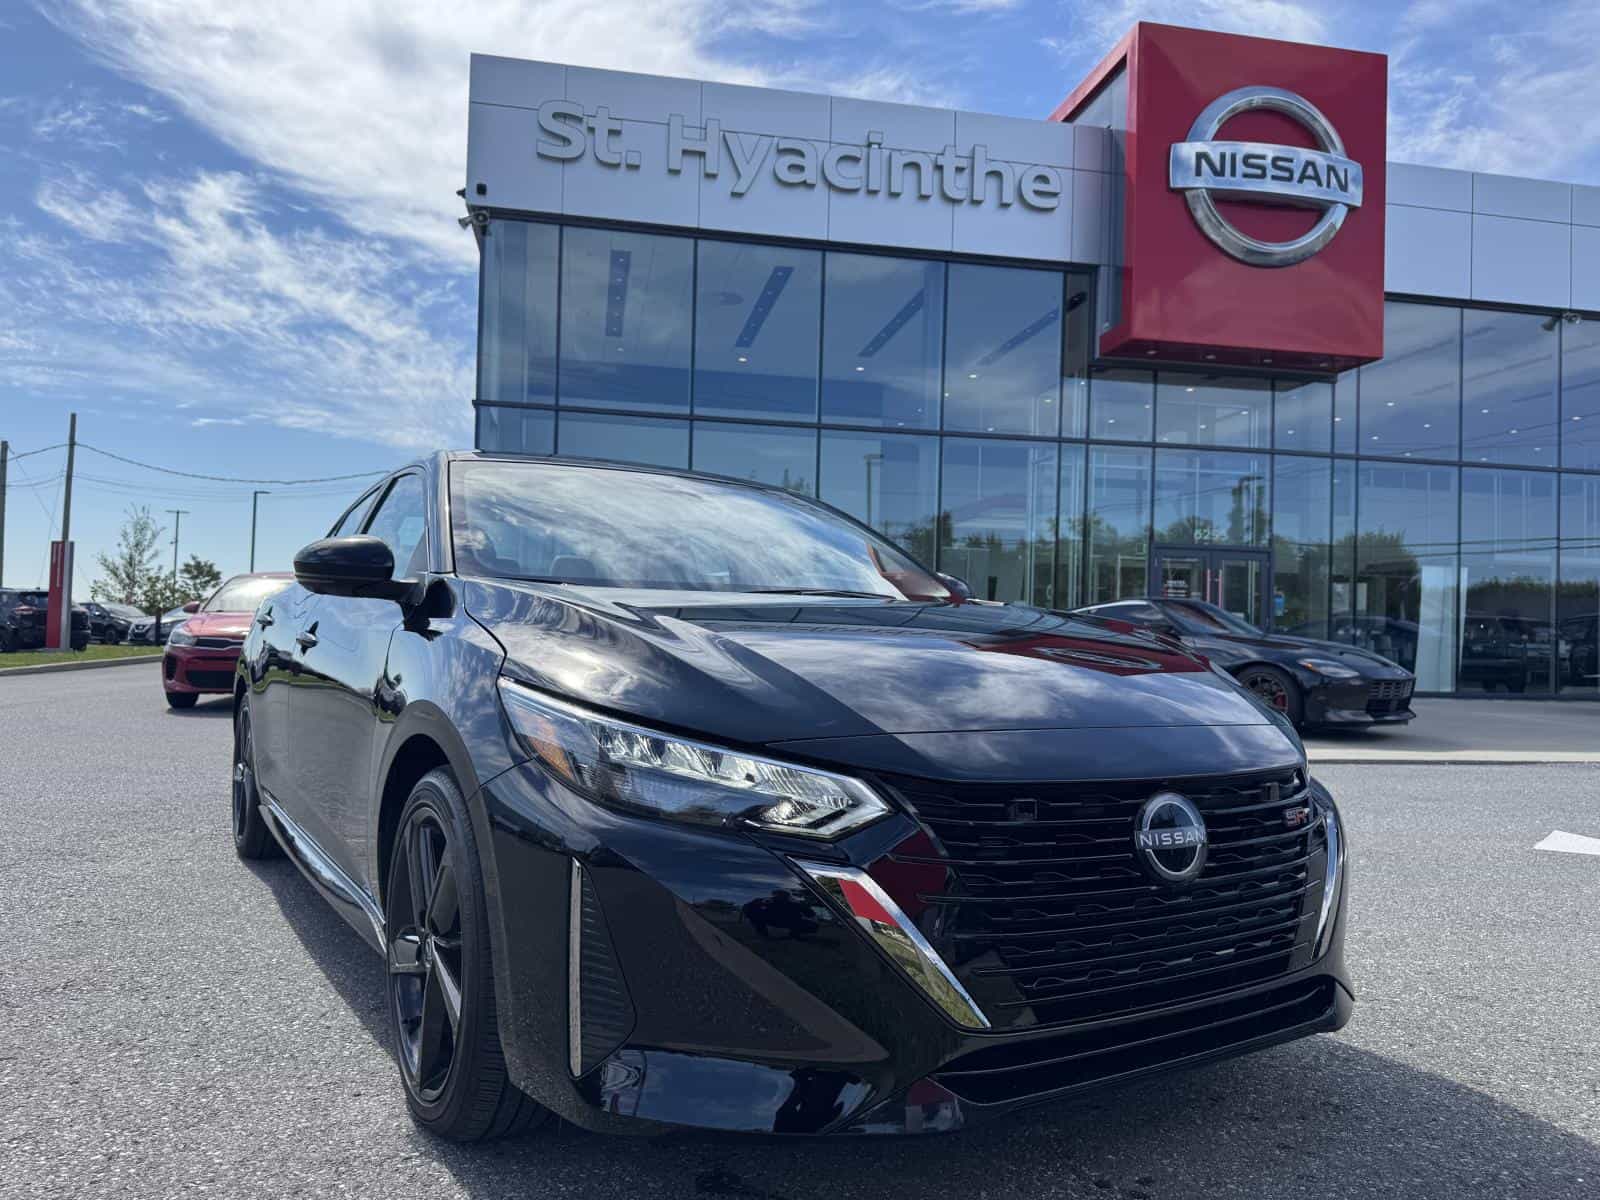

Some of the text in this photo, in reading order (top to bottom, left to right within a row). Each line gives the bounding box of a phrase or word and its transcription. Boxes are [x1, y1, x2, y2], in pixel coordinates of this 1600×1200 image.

[536, 99, 1062, 211] St. Hyacinthe
[1194, 151, 1349, 193] NISSAN
[1139, 831, 1205, 847] NISSAN
